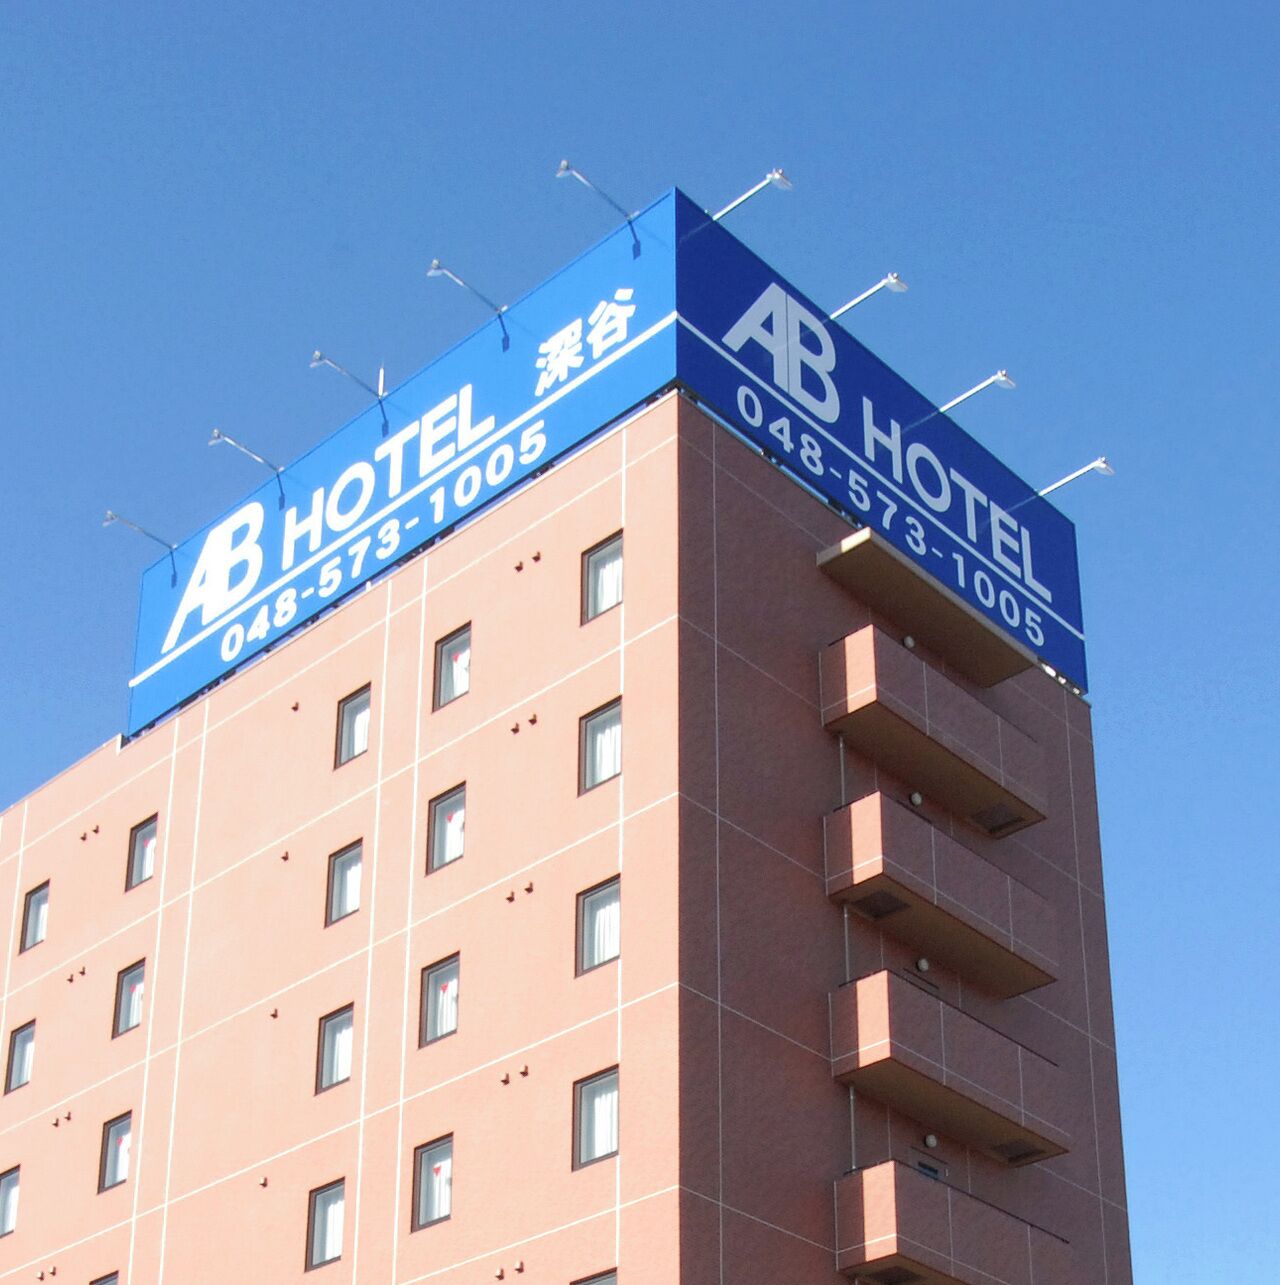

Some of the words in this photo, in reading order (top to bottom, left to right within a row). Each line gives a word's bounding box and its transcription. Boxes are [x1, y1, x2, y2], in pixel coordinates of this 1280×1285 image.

[161, 502, 264, 655] AB
[281, 384, 496, 571] HOTEL
[535, 288, 636, 398] 深谷
[220, 419, 547, 662] 048-573-1005
[722, 282, 840, 424] AB
[863, 396, 1052, 603] HOTEL
[736, 385, 1045, 647] 048-573-1005
